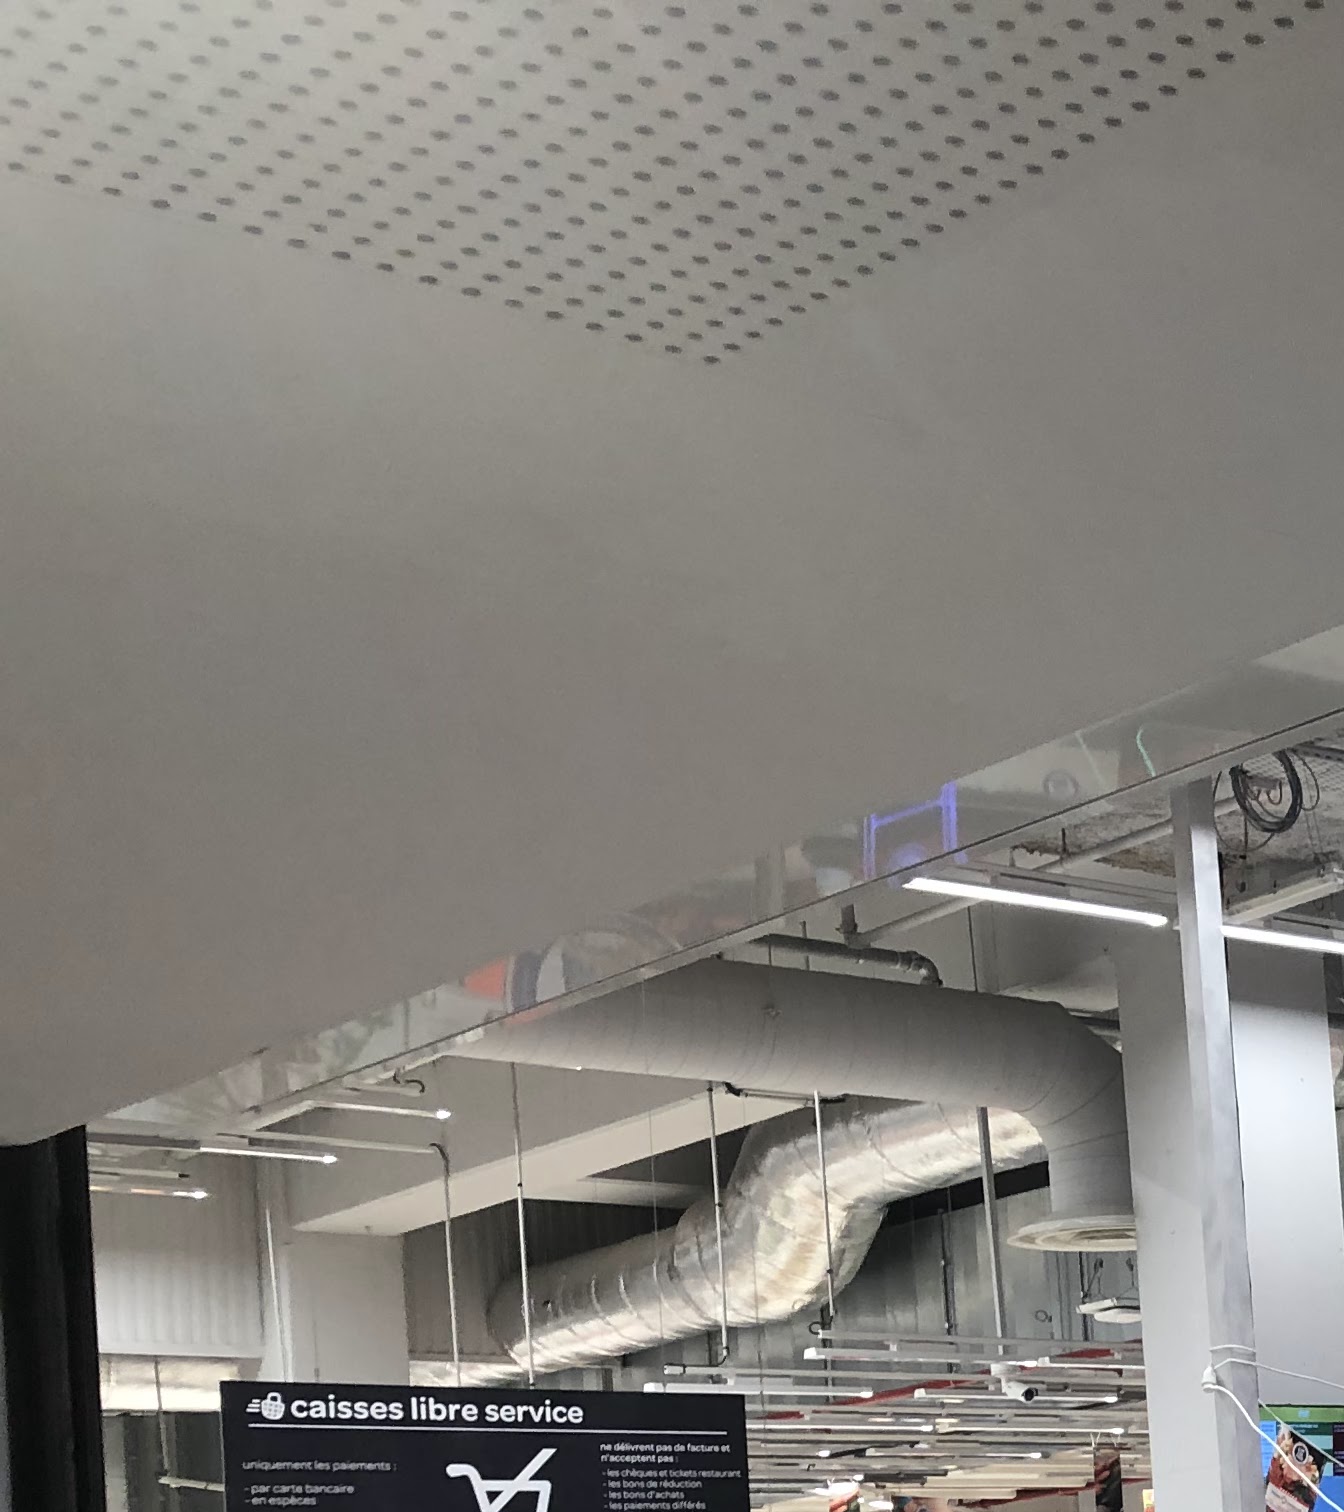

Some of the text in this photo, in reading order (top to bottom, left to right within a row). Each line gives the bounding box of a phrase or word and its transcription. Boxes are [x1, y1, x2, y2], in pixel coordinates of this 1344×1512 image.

[290, 1394, 584, 1424] caisses libre service
